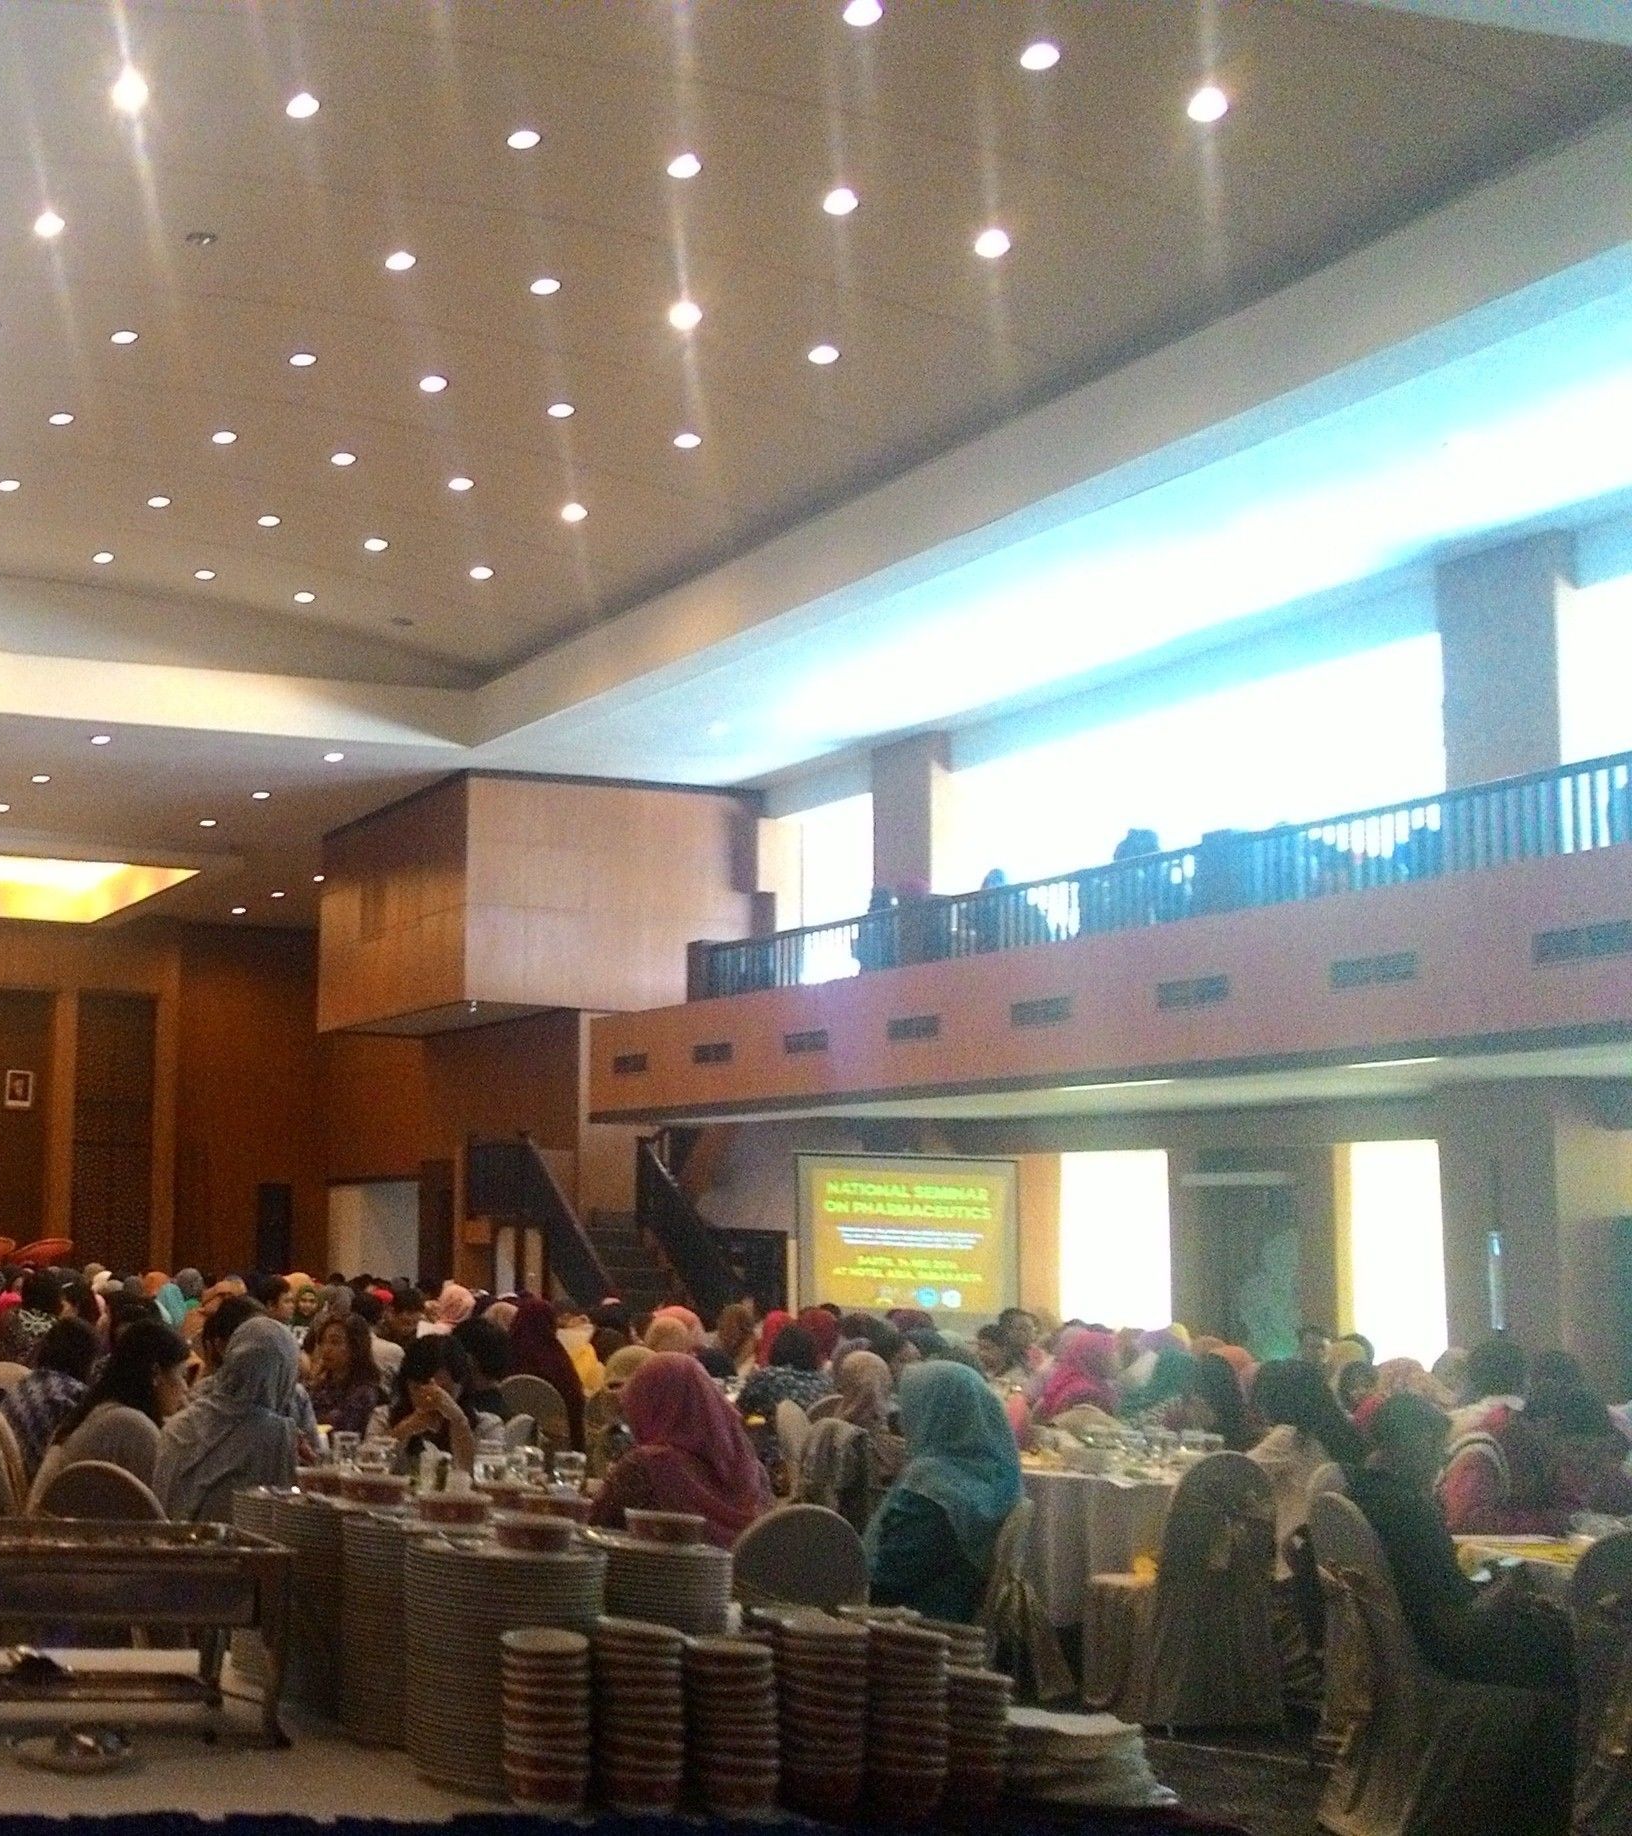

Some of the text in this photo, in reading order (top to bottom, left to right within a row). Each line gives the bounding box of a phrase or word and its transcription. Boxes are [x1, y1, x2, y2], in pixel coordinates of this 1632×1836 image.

[827, 1182, 988, 1201] NATIONAL SEMINAR
[824, 1200, 992, 1219] ON PHARMACEUTICS
